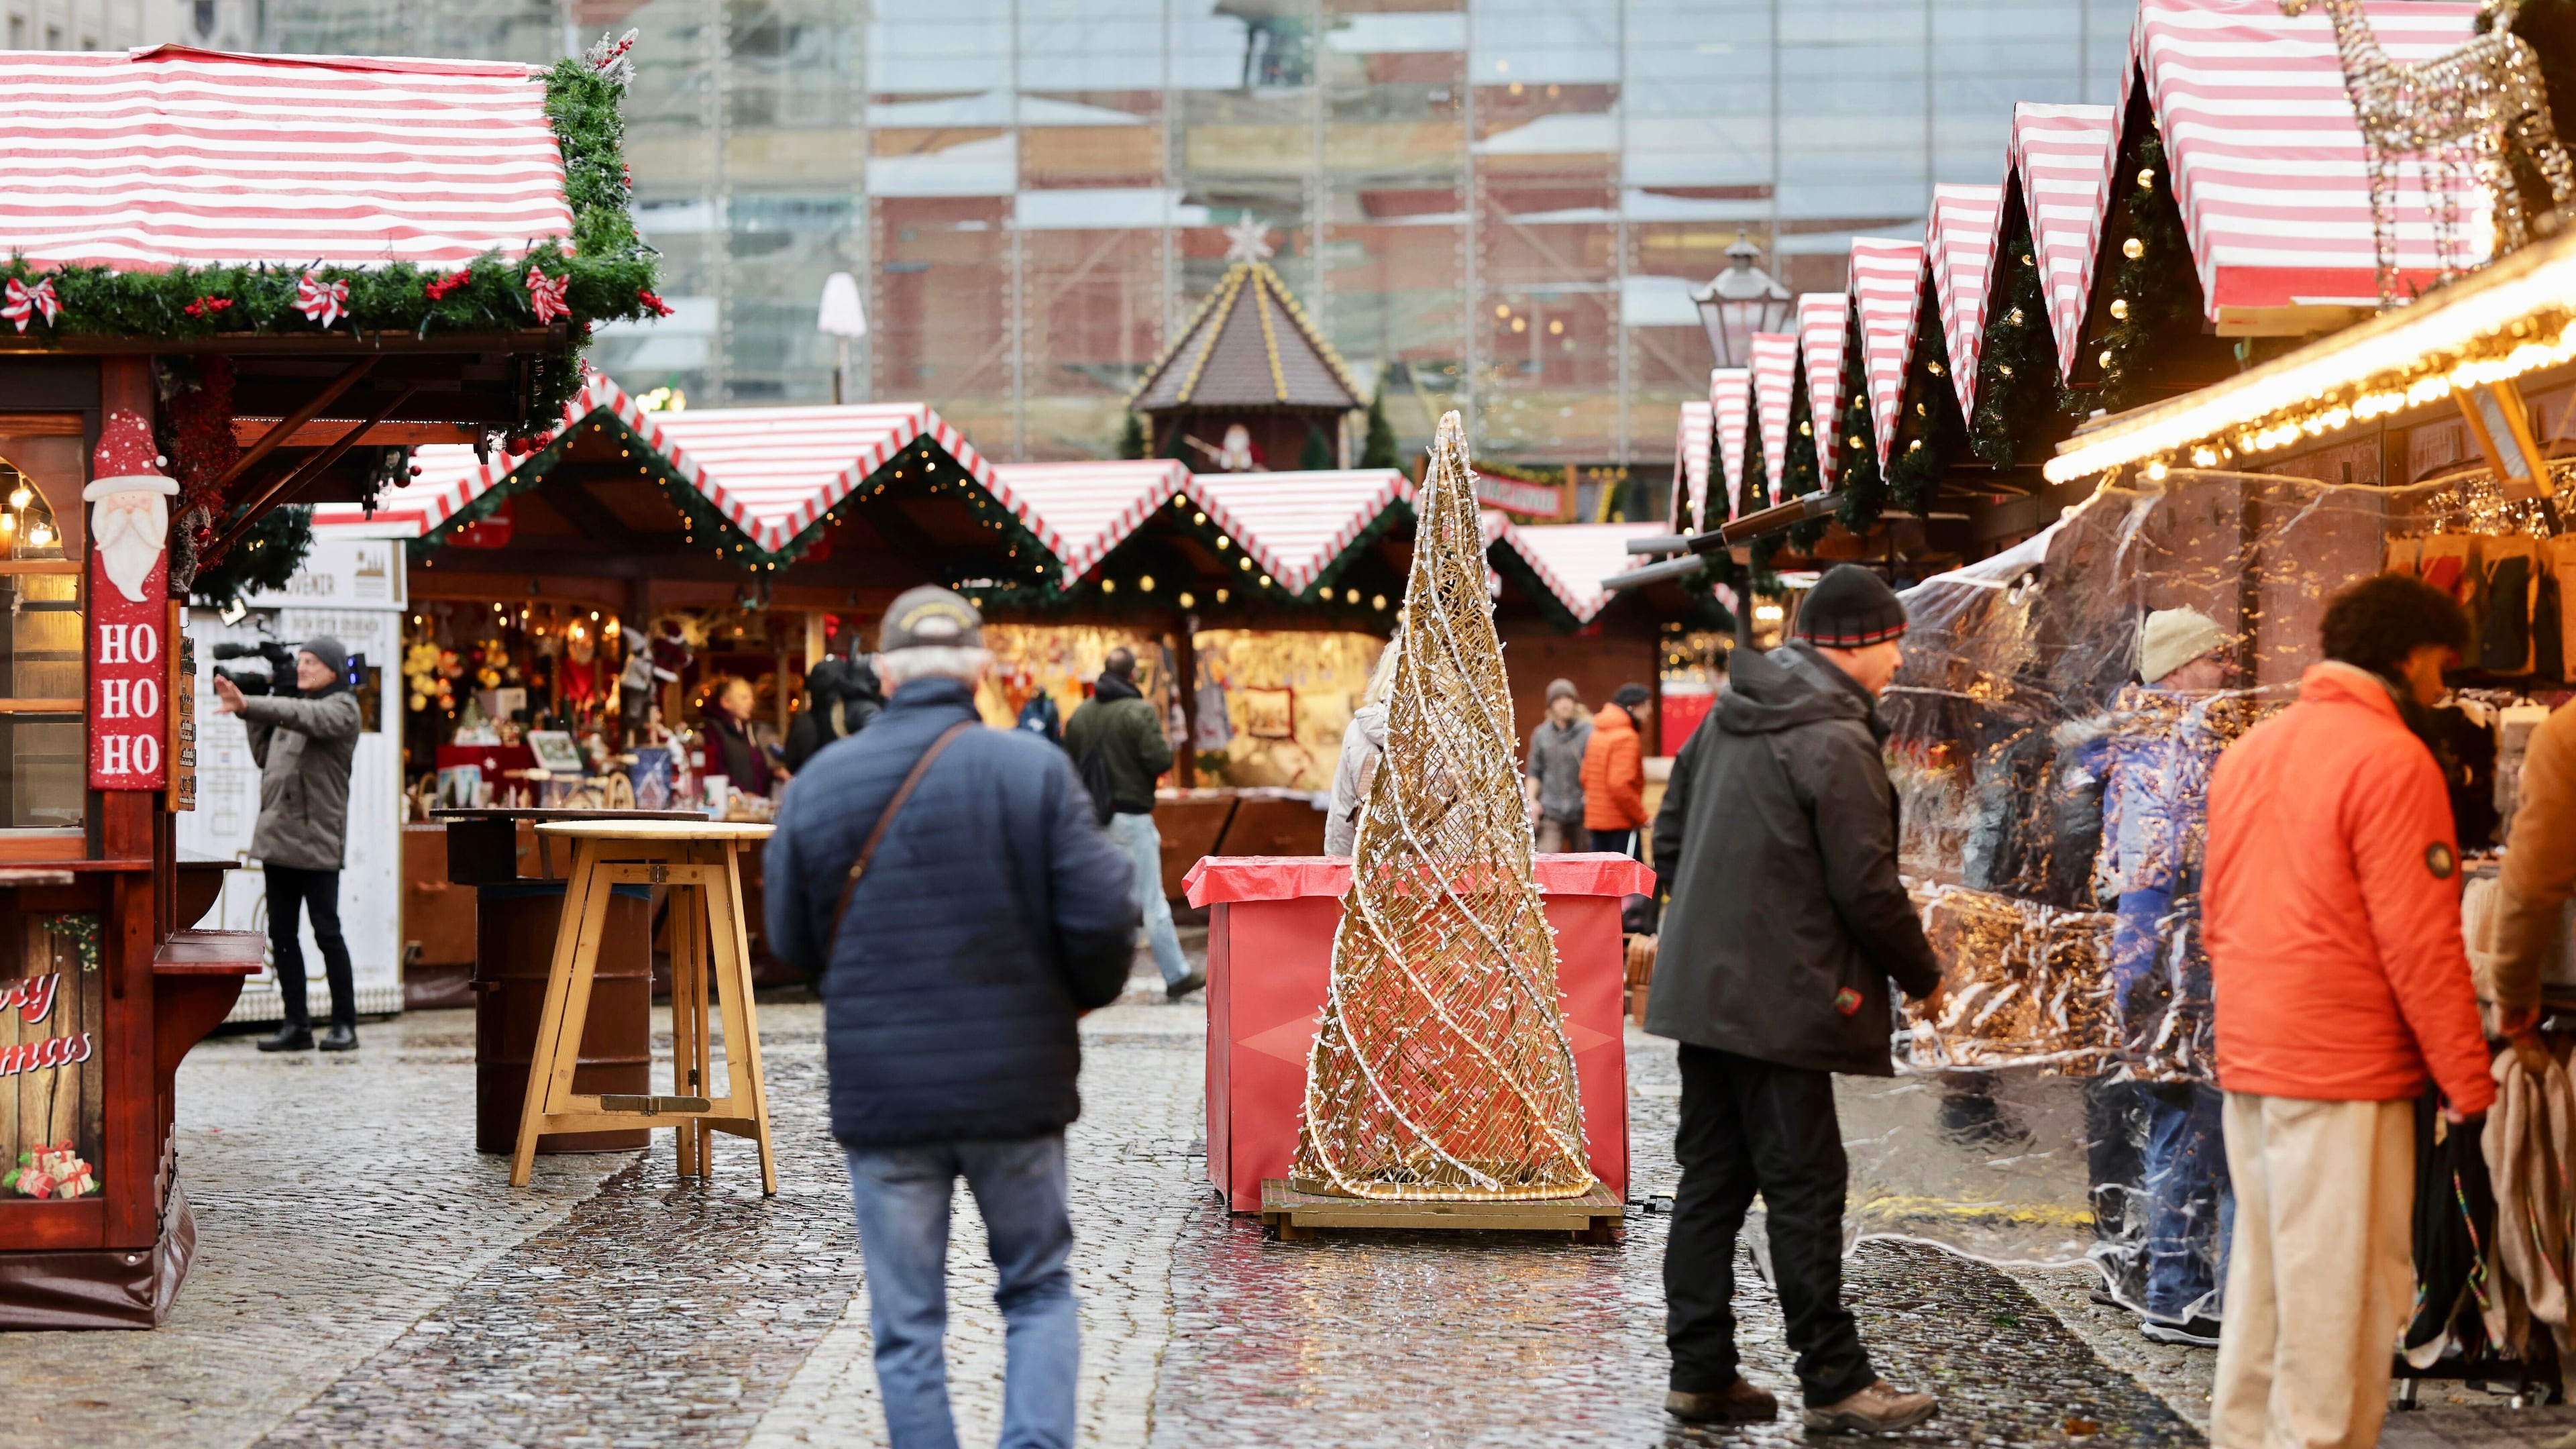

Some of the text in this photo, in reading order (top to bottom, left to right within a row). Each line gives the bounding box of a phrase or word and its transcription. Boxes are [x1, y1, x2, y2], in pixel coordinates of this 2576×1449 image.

[99, 623, 158, 663] HO
[101, 678, 159, 718] HO
[101, 734, 160, 774] HO
